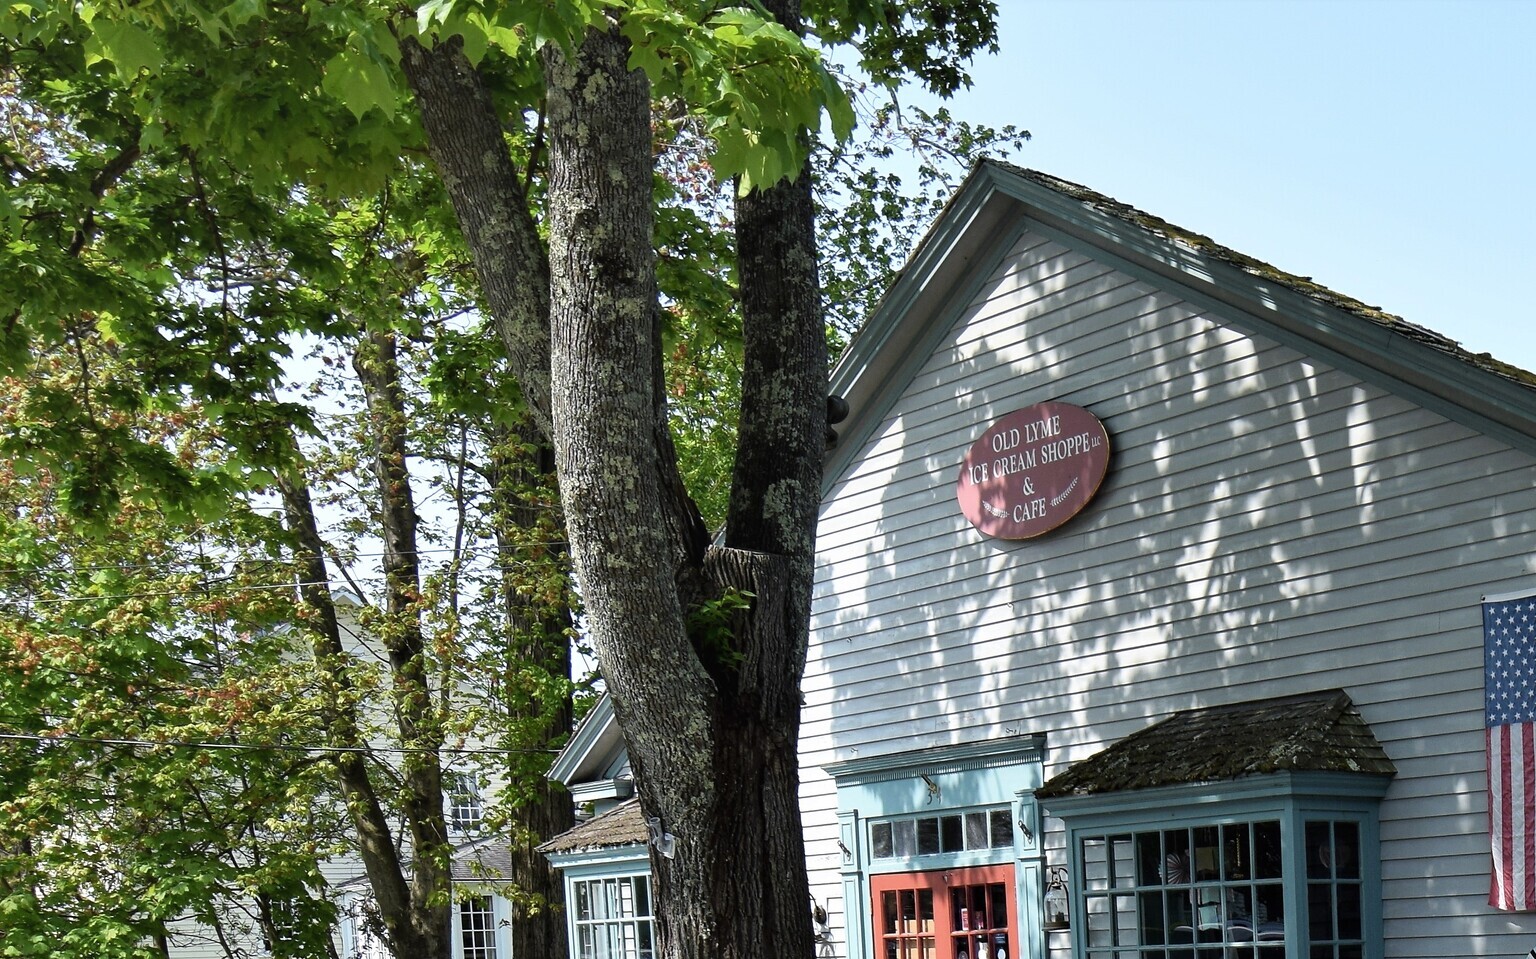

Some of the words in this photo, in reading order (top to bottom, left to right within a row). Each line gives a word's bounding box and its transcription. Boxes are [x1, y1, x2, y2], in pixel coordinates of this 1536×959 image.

[992, 428, 1020, 453] OLD
[1025, 415, 1061, 444] LYME
[968, 462, 989, 486] ICE
[993, 448, 1037, 479] CREAM
[1041, 432, 1091, 464] SHOPPE
[1023, 476, 1035, 496] &
[1013, 497, 1047, 523] CAFE
